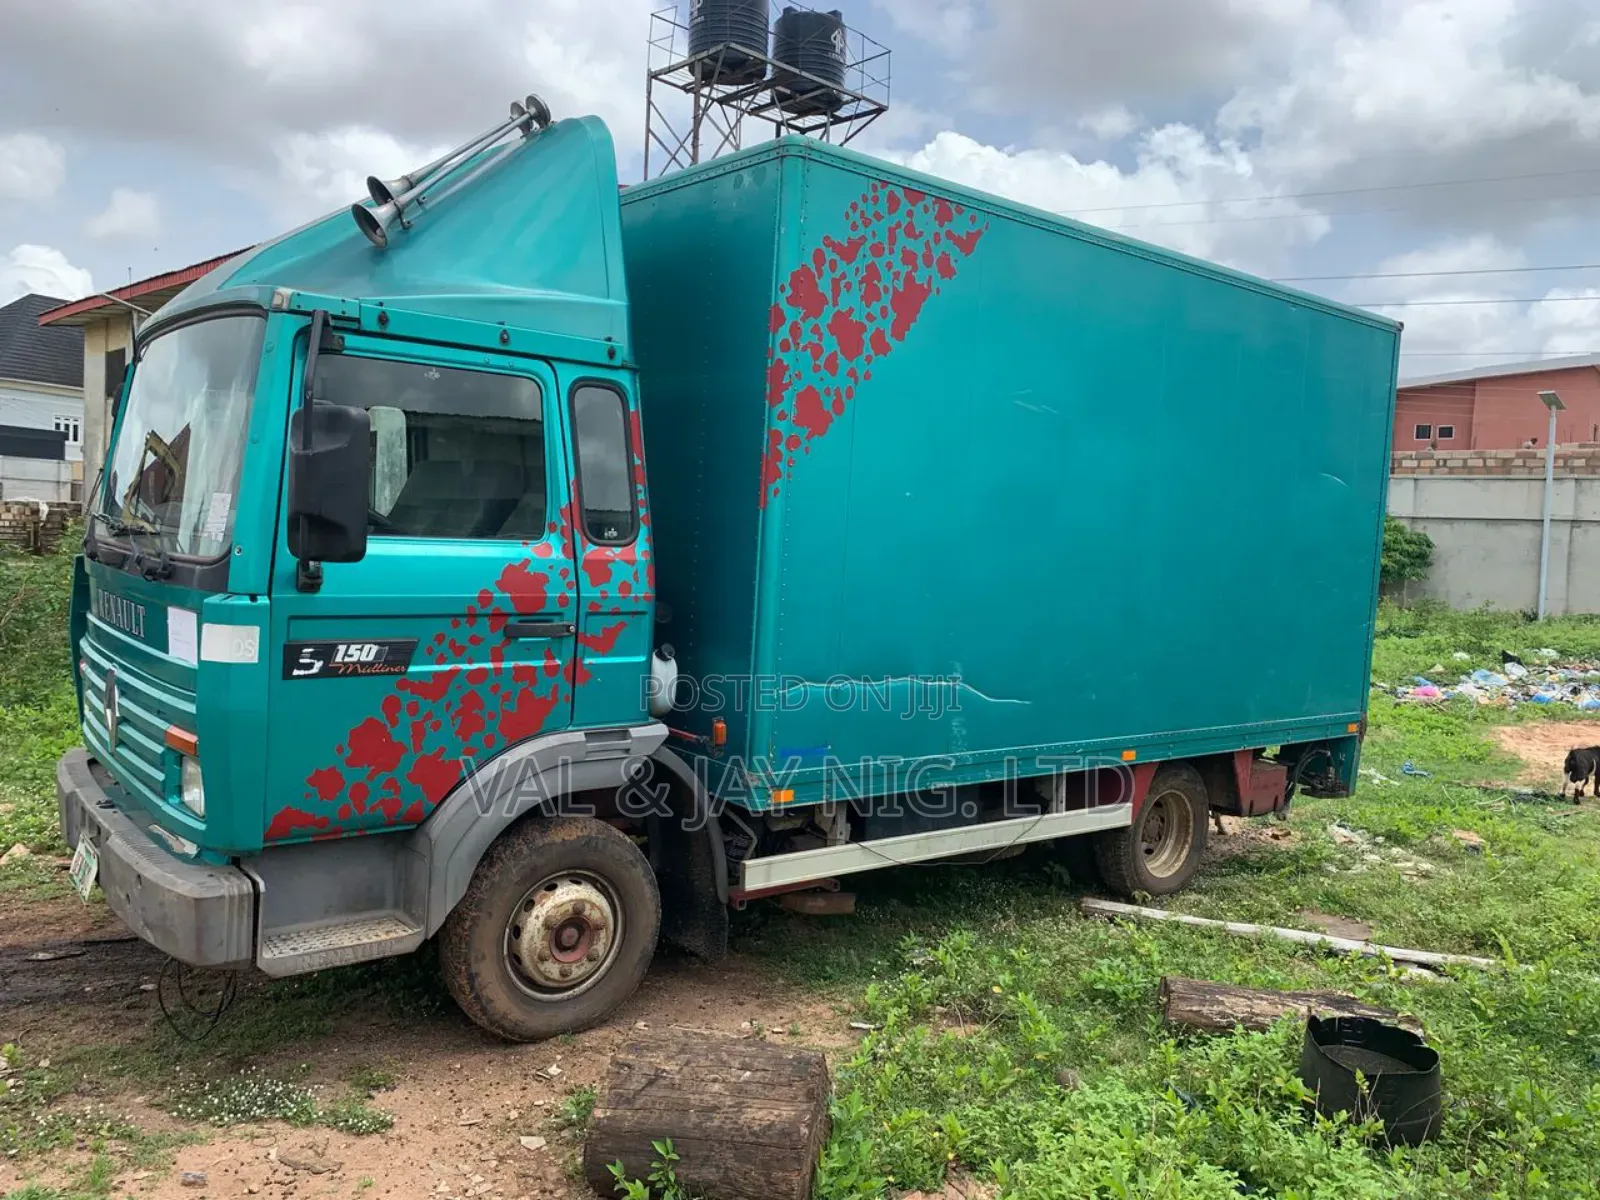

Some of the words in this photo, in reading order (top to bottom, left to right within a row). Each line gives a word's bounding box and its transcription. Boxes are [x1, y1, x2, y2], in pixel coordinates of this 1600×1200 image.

[98, 589, 145, 638] RENAULT
[334, 644, 379, 662] 150
[329, 663, 406, 675] Midliner
